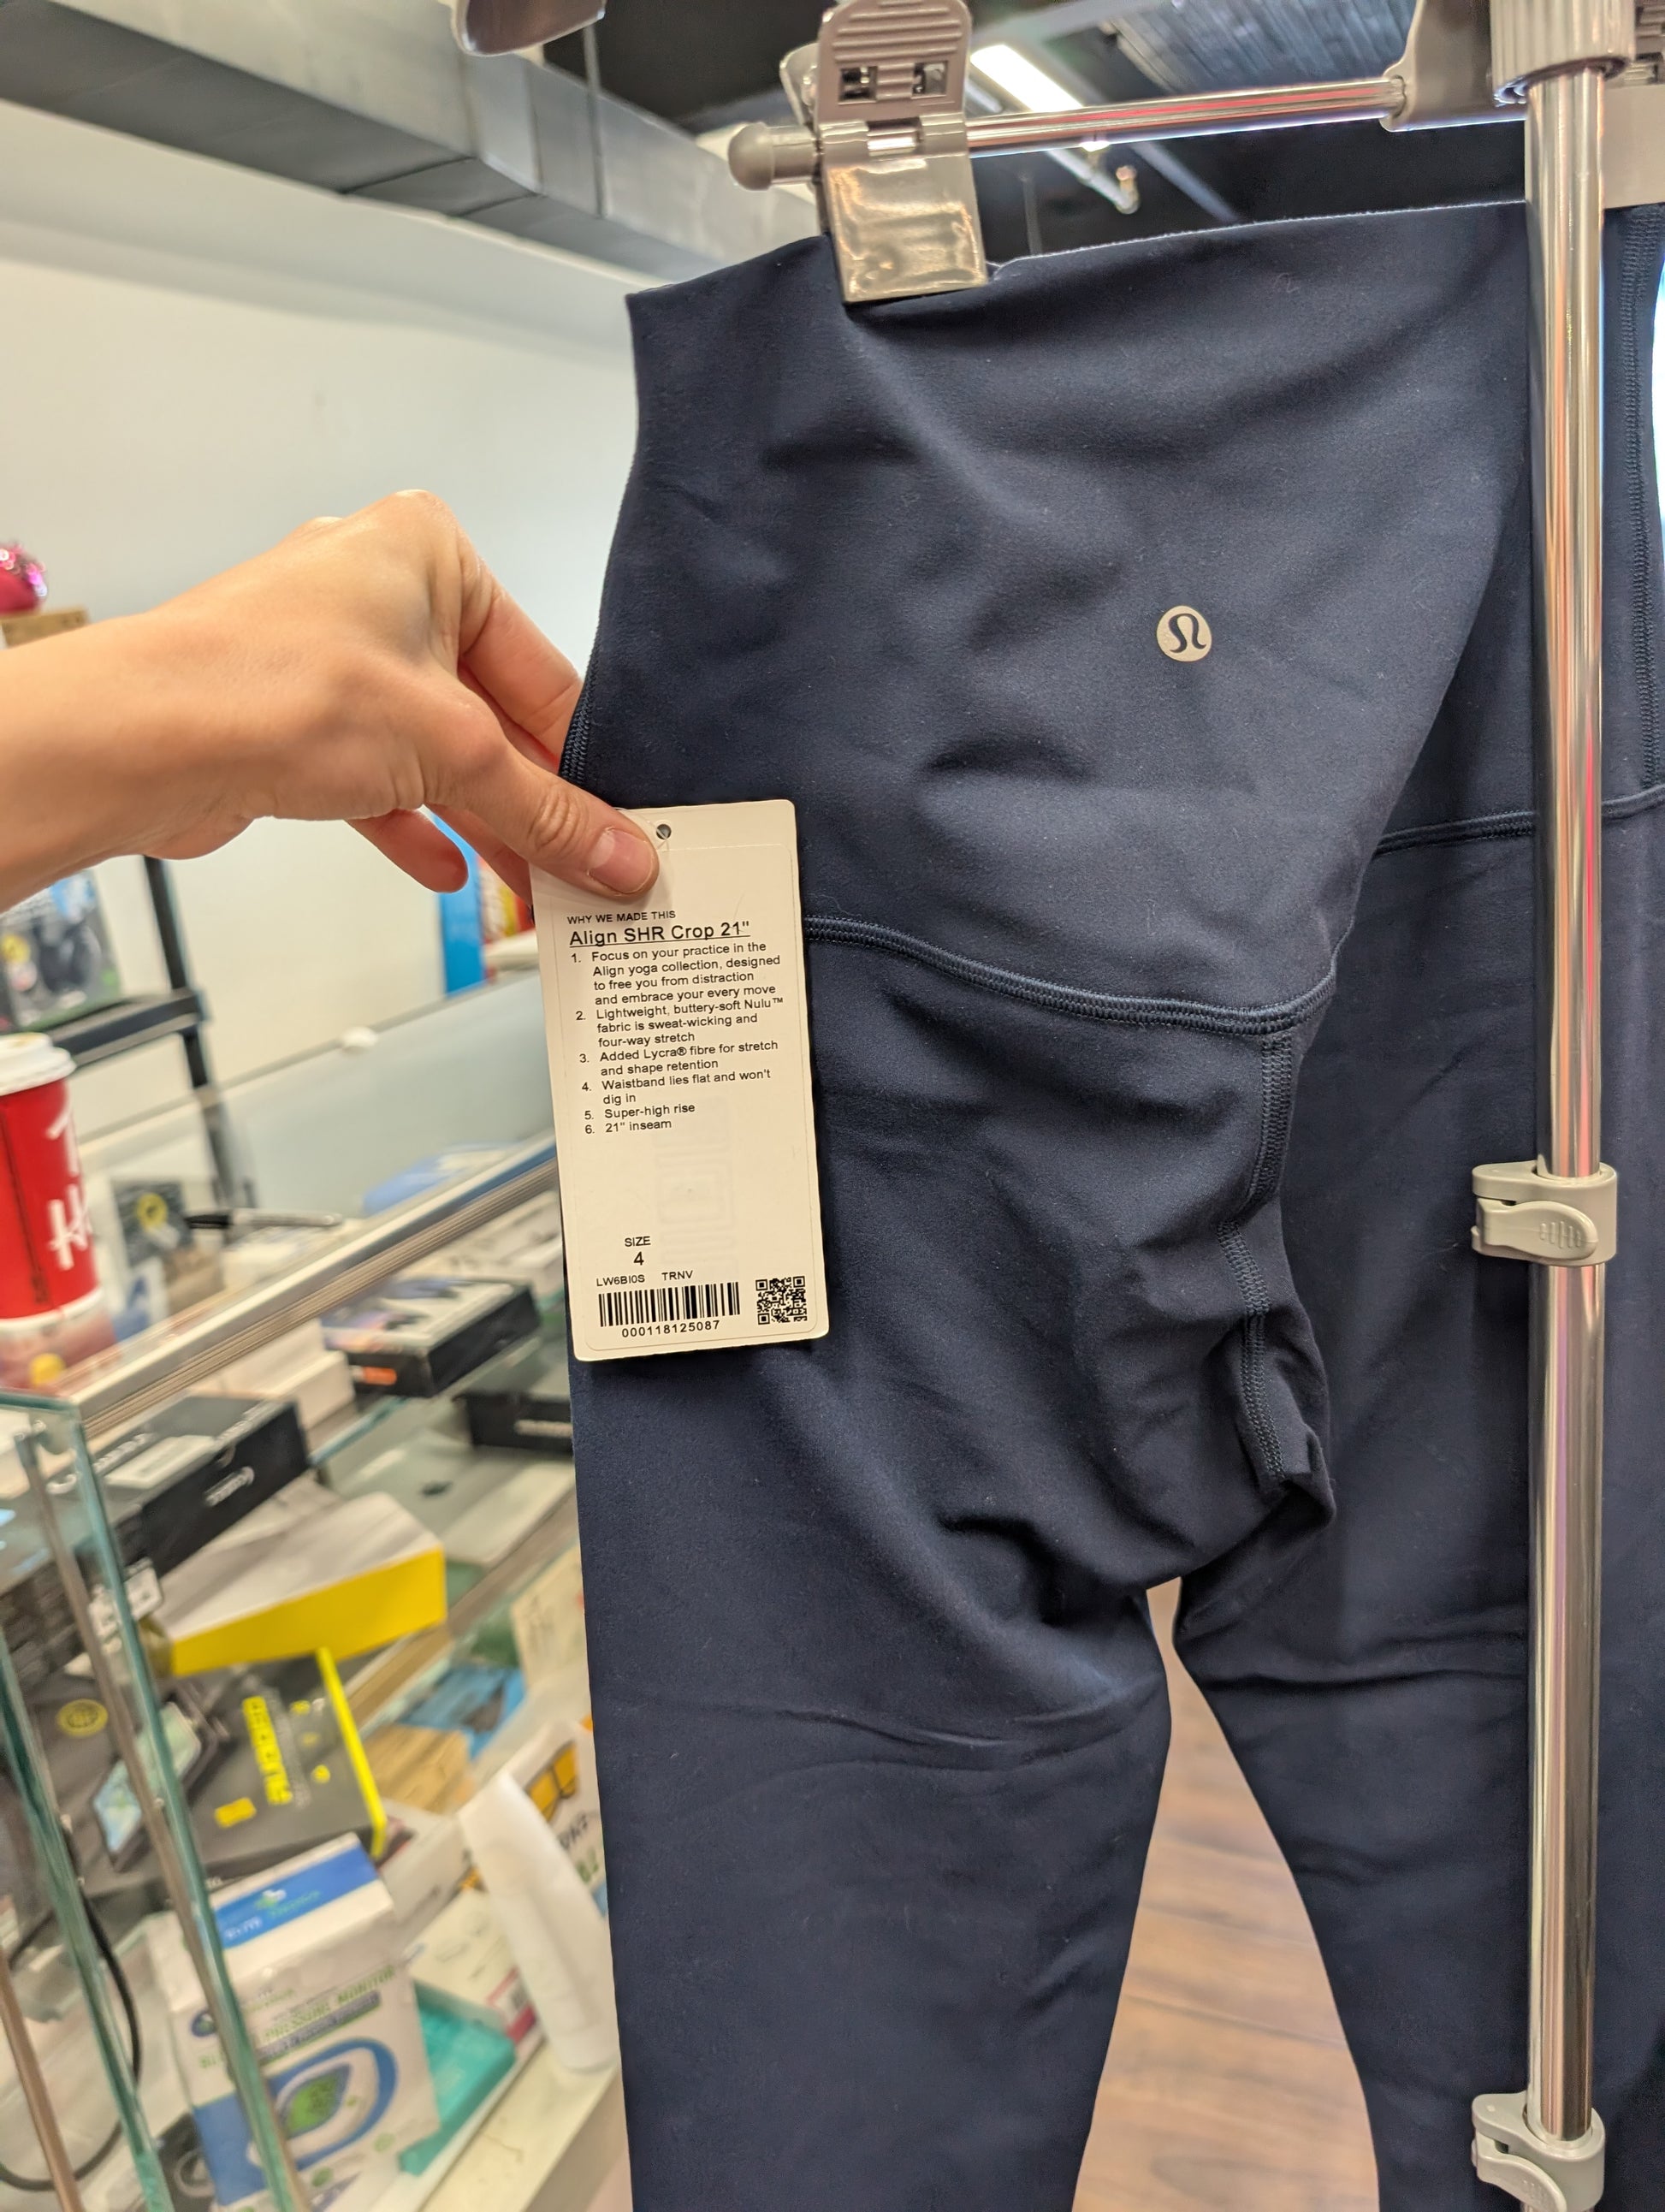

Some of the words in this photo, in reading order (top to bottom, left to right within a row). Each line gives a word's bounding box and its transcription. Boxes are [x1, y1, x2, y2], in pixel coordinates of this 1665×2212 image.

[567, 915, 592, 924] WHY
[595, 914, 613, 922] WE
[617, 912, 648, 922] MADE
[651, 910, 675, 920] THIS
[570, 930, 617, 946] Align
[624, 926, 665, 941] SHR
[671, 925, 714, 940] Crop
[720, 921, 750, 936] 21"
[572, 953, 581, 963] 1.
[592, 950, 629, 962] Focus
[633, 951, 649, 959] on
[652, 948, 678, 960] your
[683, 944, 730, 958] practice
[733, 944, 744, 952] in
[748, 942, 766, 952] the
[593, 965, 625, 977] Align
[628, 964, 658, 976] yoga
[662, 960, 722, 972] collection,
[726, 956, 780, 969] designed
[595, 981, 606, 990] to
[609, 978, 631, 989] free
[636, 978, 657, 990] you
[661, 976, 689, 987] from
[692, 972, 754, 984] distraction
[595, 994, 618, 1005] and
[622, 992, 673, 1004] embrace
[678, 990, 704, 1002] your
[708, 987, 739, 999] every
[744, 986, 775, 994] move
[576, 1011, 586, 1020] 2.
[596, 1006, 670, 1020] Lightweight,
[673, 1000, 741, 1014] buttery-soft
[597, 1022, 631, 1033] fabric
[635, 1022, 644, 1030] is
[649, 1015, 732, 1029] sweat-wicking
[736, 1013, 757, 1023] and
[598, 1035, 651, 1047] four-way
[655, 1033, 695, 1043] stretch
[580, 1054, 590, 1063] 3.
[600, 1050, 639, 1062] Added
[690, 1045, 715, 1055] fibre
[719, 1044, 735, 1053] for
[738, 1041, 778, 1052] stretch
[601, 1065, 623, 1076] and
[627, 1063, 663, 1075] shape
[667, 1059, 718, 1070] retention
[582, 1082, 591, 1091] 4.
[602, 1077, 666, 1090] Waistband
[669, 1076, 689, 1086] lies
[692, 1074, 711, 1084] flat
[714, 1071, 736, 1082] and
[739, 1070, 771, 1080] won't
[603, 1094, 621, 1106] dig
[625, 1093, 637, 1103] in
[584, 1111, 594, 1119] 5.
[605, 1105, 670, 1119] Super-high
[673, 1103, 695, 1113] rise
[585, 1125, 595, 1135] 6.
[606, 1122, 625, 1133] 21"
[629, 1119, 672, 1131] inseam
[625, 1236, 651, 1247] SIZE
[633, 1252, 644, 1266] 4
[661, 1271, 693, 1281] TRNV
[622, 1320, 720, 1337] 000118125087
